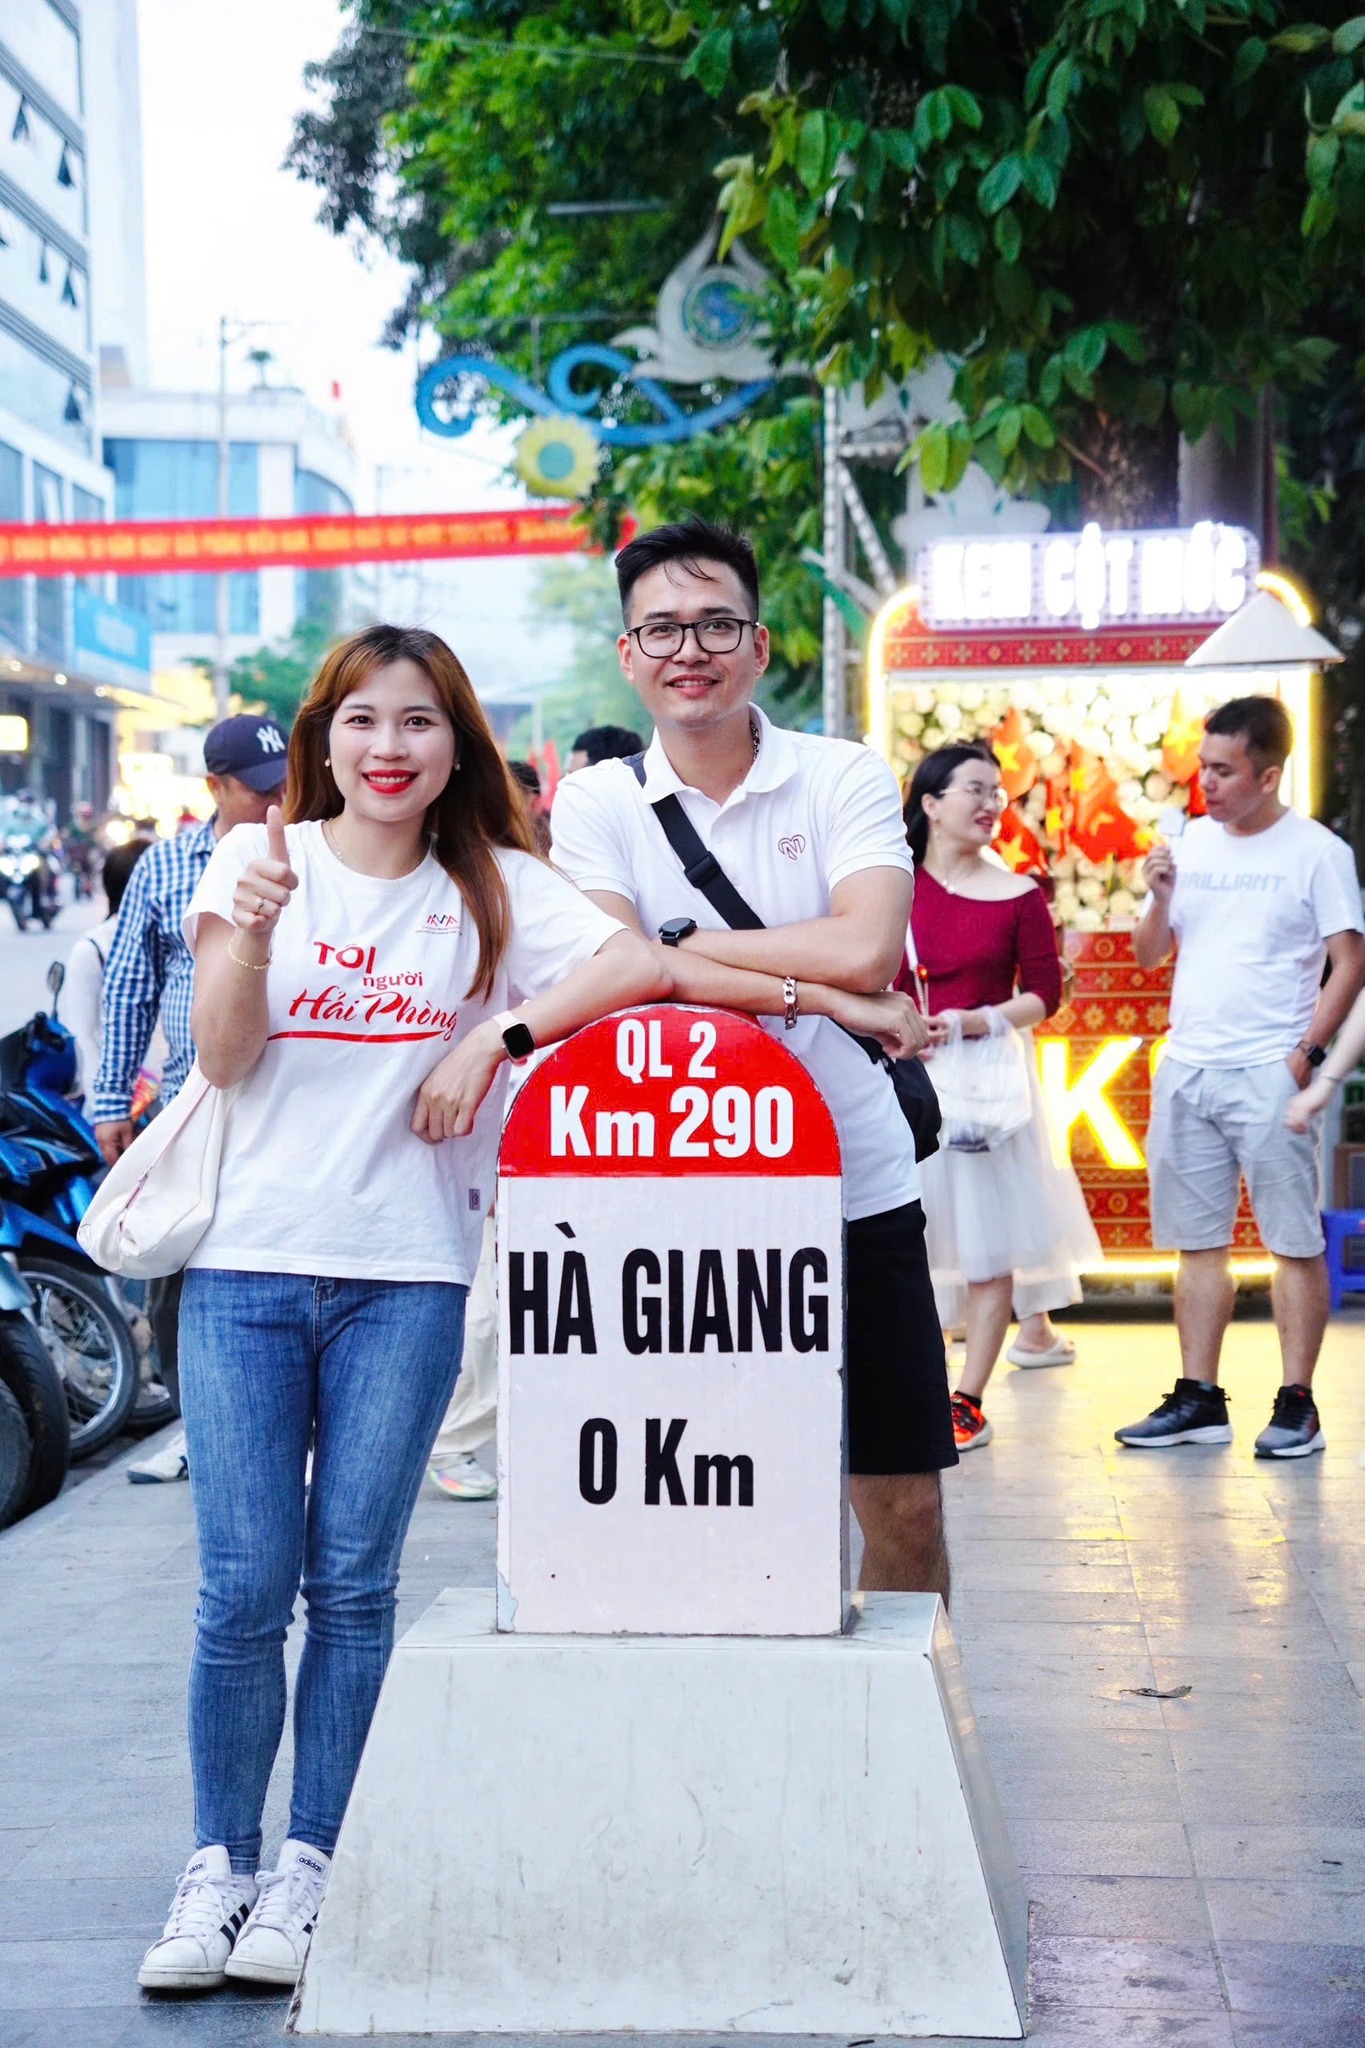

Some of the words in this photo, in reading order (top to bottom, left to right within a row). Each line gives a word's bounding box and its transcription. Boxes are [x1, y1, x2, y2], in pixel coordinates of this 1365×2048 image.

[314, 942, 376, 974] TÔI
[363, 971, 423, 990] người
[288, 985, 359, 1021] Hải
[362, 991, 457, 1041] Phòng
[616, 1019, 673, 1084] QL
[688, 1021, 717, 1079] 2
[550, 1086, 655, 1157] Km
[669, 1086, 794, 1159] 290
[509, 1221, 598, 1355] HÀ
[622, 1247, 829, 1355] GIANG
[579, 1417, 618, 1505] 0
[644, 1418, 754, 1506] Km
[299, 1856, 323, 1873] adidas
